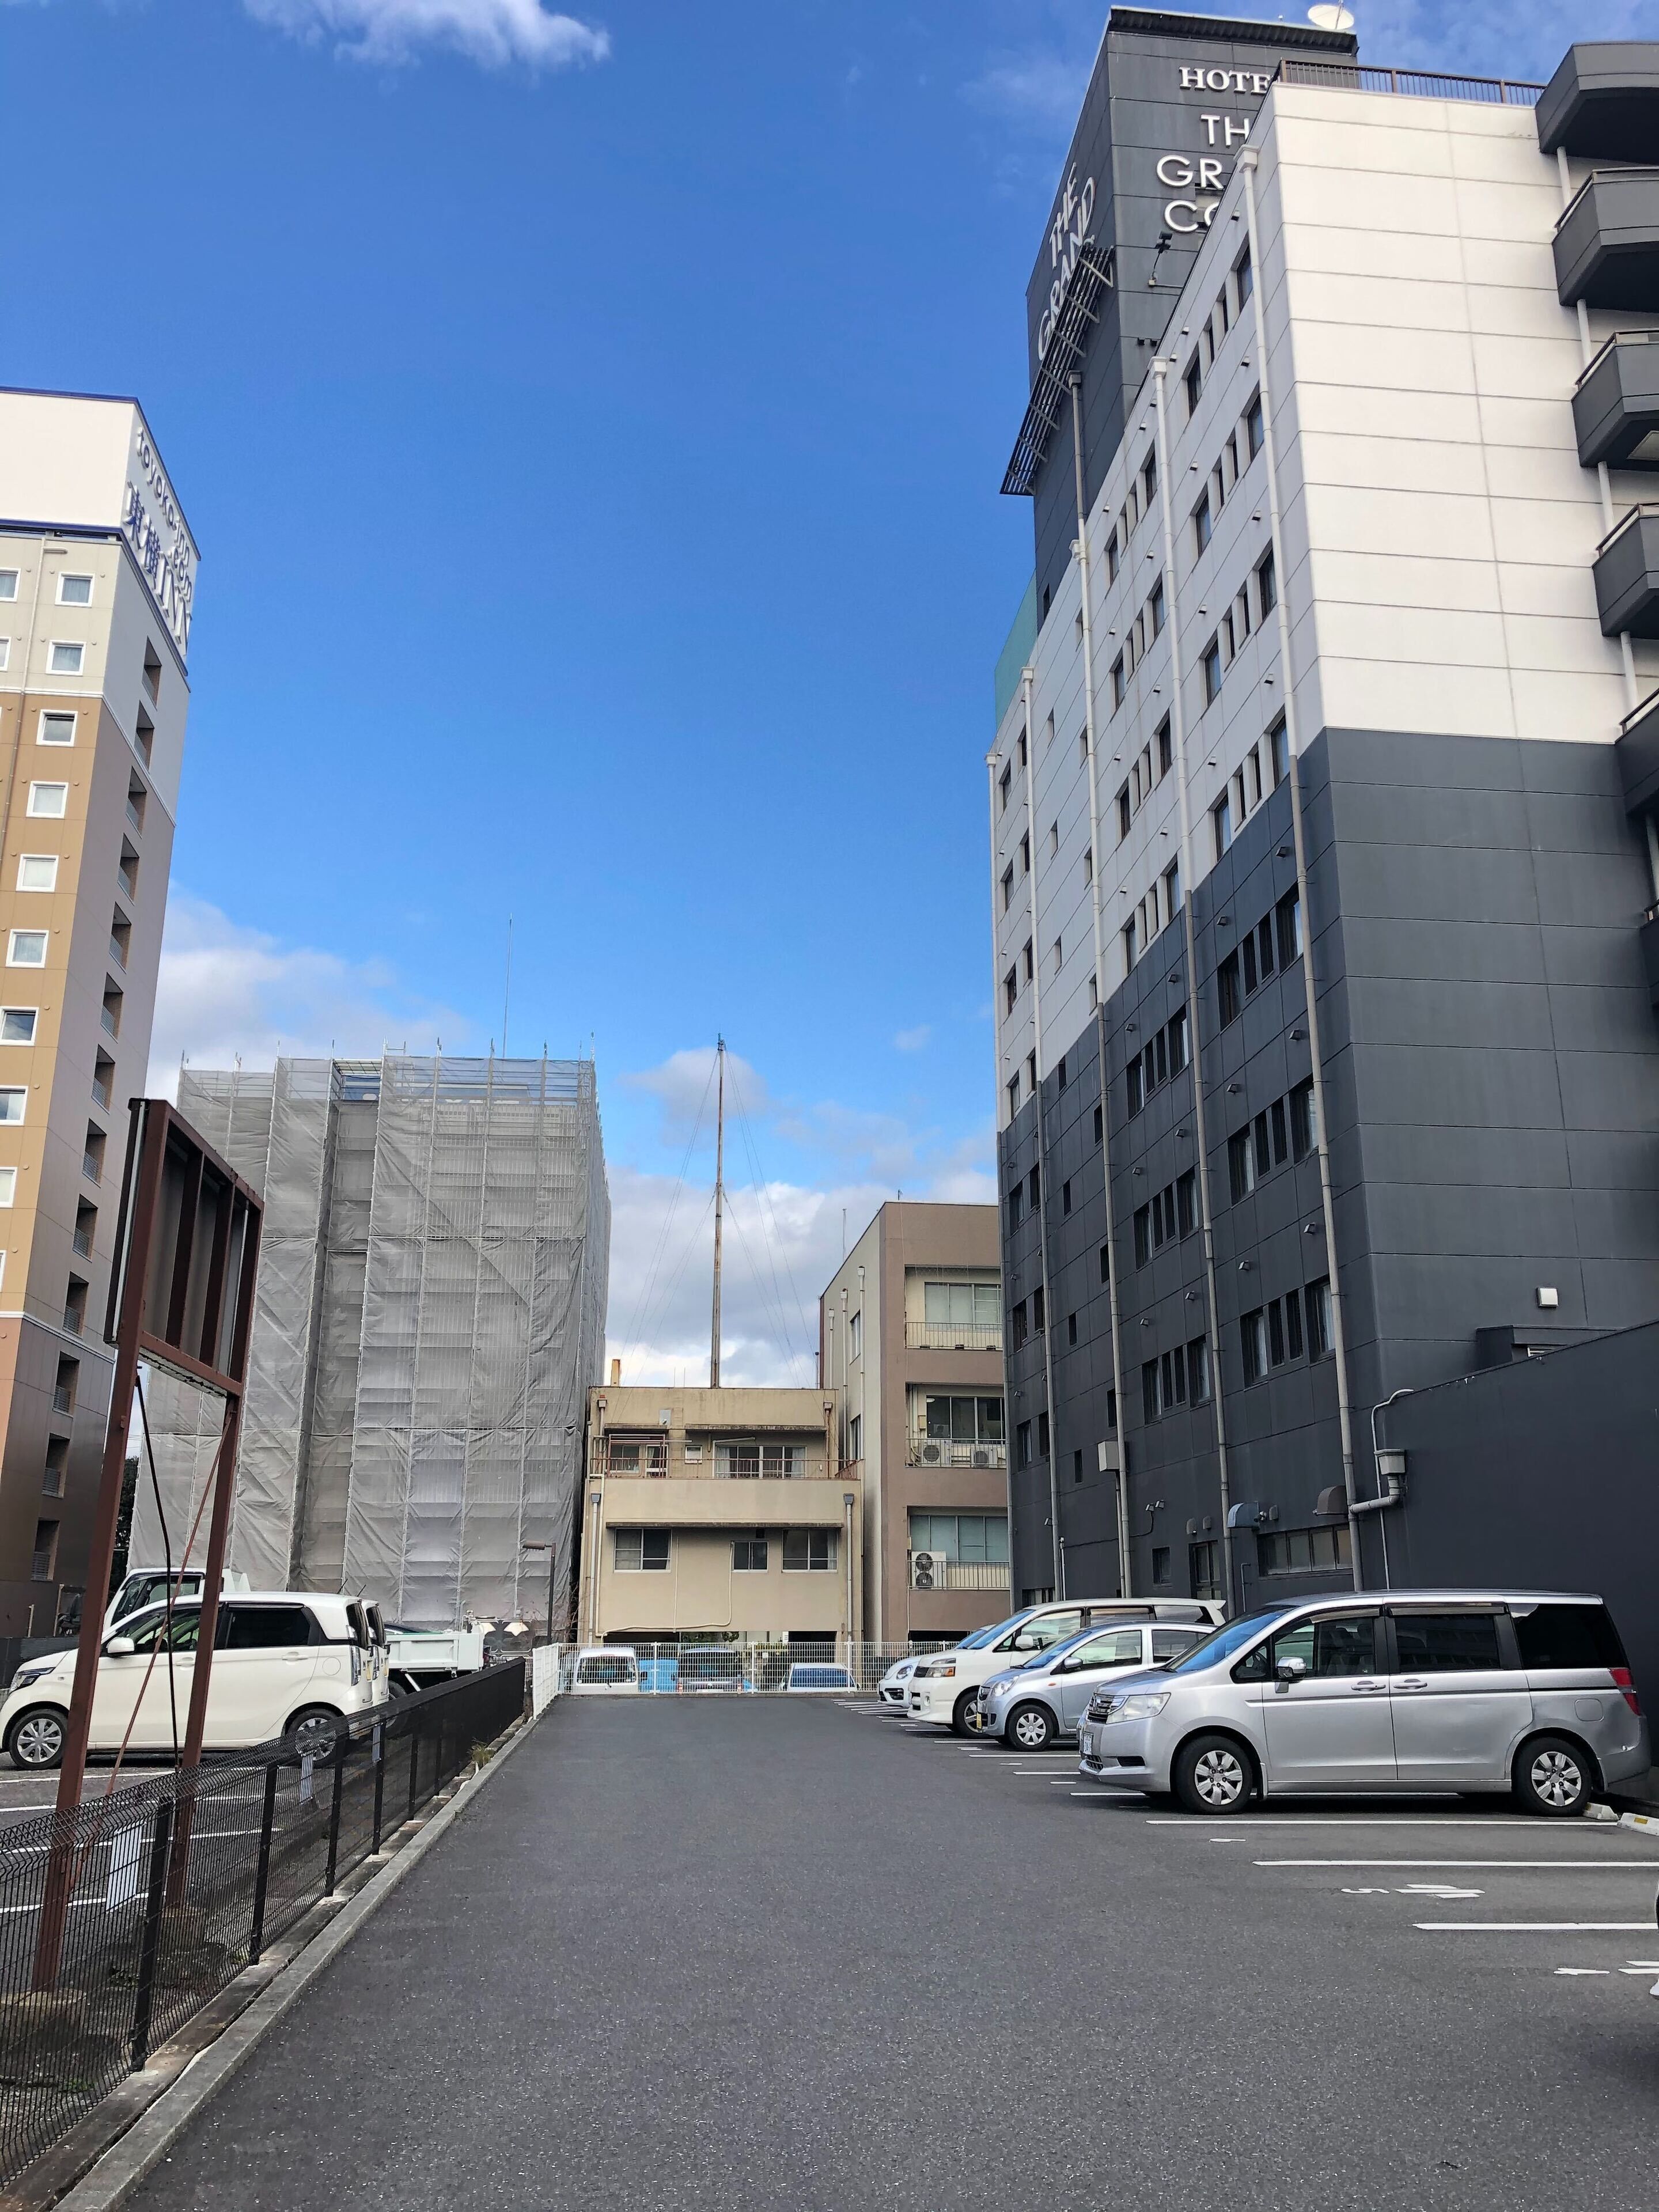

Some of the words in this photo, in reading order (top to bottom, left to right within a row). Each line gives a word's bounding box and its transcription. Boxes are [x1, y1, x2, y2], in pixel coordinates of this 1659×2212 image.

[1179, 66, 1271, 94] HOTE
[1200, 114, 1249, 146] TH
[1049, 162, 1078, 270] THE
